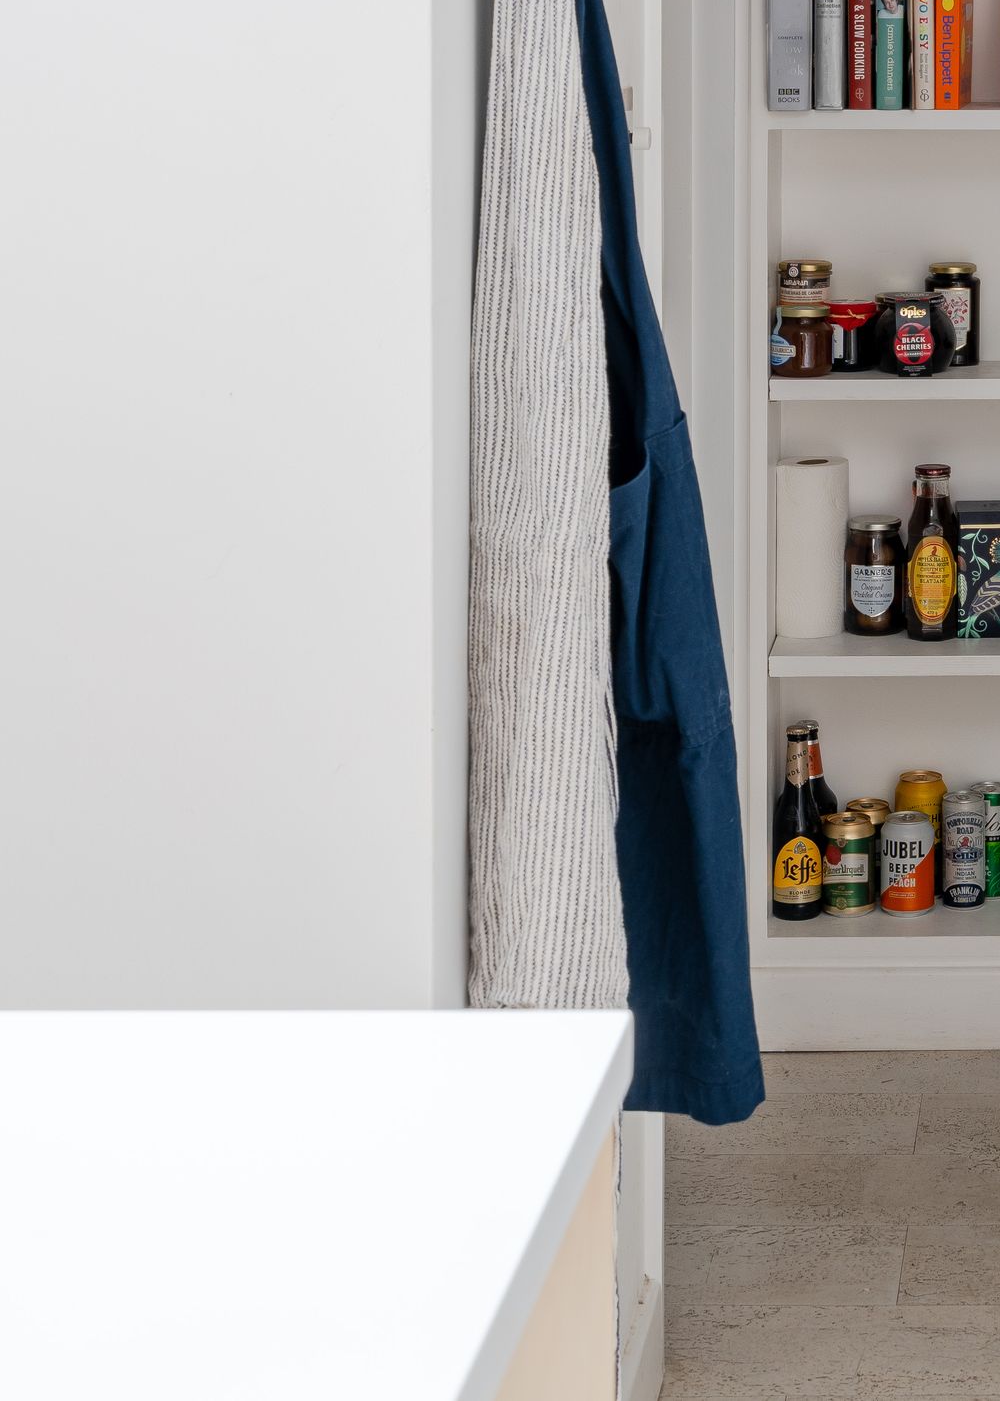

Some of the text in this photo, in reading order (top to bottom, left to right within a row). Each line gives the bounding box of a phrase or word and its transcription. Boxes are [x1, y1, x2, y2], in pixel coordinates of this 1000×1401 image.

[854, 4, 865, 12] &
[854, 14, 865, 39] SLOW
[939, 15, 954, 86] Ben Lippett
[854, 41, 865, 80] COOKING
[886, 58, 896, 91] dinners
[900, 305, 927, 318] Opies
[902, 336, 926, 344] BLACK
[854, 568, 892, 577] GARNER'S
[861, 583, 884, 592] Original
[947, 818, 983, 829] PORTOBELLO
[956, 827, 974, 835] ROAD
[883, 839, 925, 859] JUBEL
[782, 854, 819, 885] Leffe
[889, 862, 916, 874] BEER
[889, 877, 916, 888] PEACH
[949, 886, 980, 897] FRANKLIN
